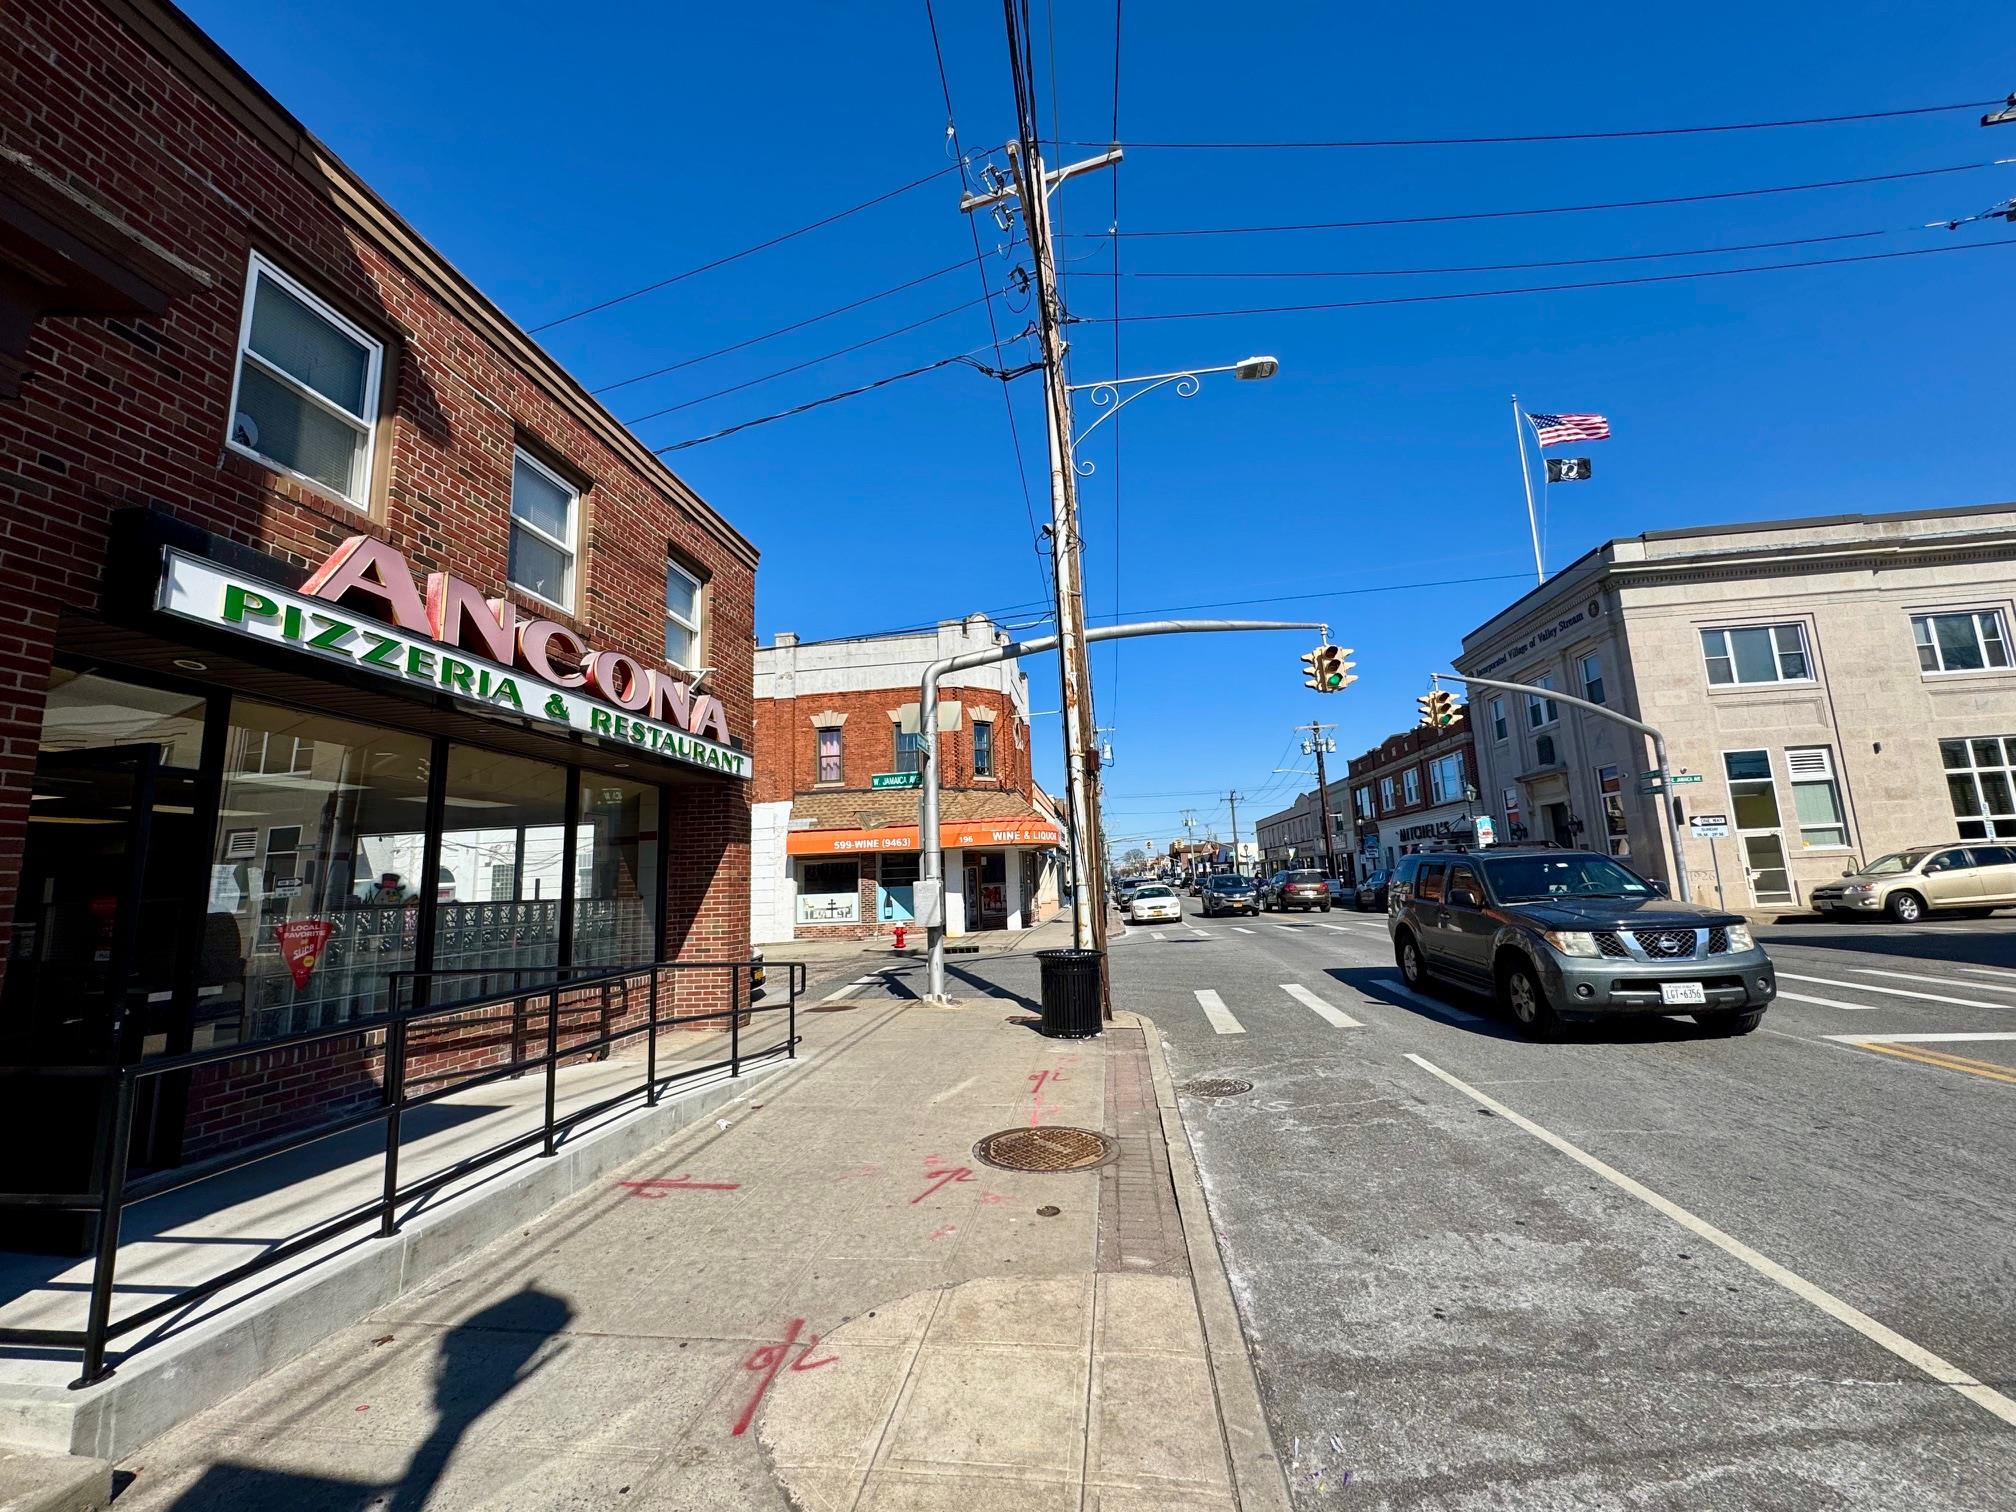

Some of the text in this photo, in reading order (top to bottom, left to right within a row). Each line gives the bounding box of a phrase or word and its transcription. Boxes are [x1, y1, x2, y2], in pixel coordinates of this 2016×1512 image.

[298, 535, 732, 747] ANCONA
[1476, 613, 1584, 677] Incorporated Village of Valley Stream
[221, 583, 744, 774] PIZZERIA & RESTAURANT
[883, 776, 907, 786] JAMAICA
[959, 835, 973, 843] 196
[992, 831, 1020, 841] WINE
[1024, 831, 1030, 840] &
[834, 838, 911, 850] 599-WINE (9463)
[291, 924, 320, 932] LOCAL
[284, 930, 326, 939] FAVORITE
